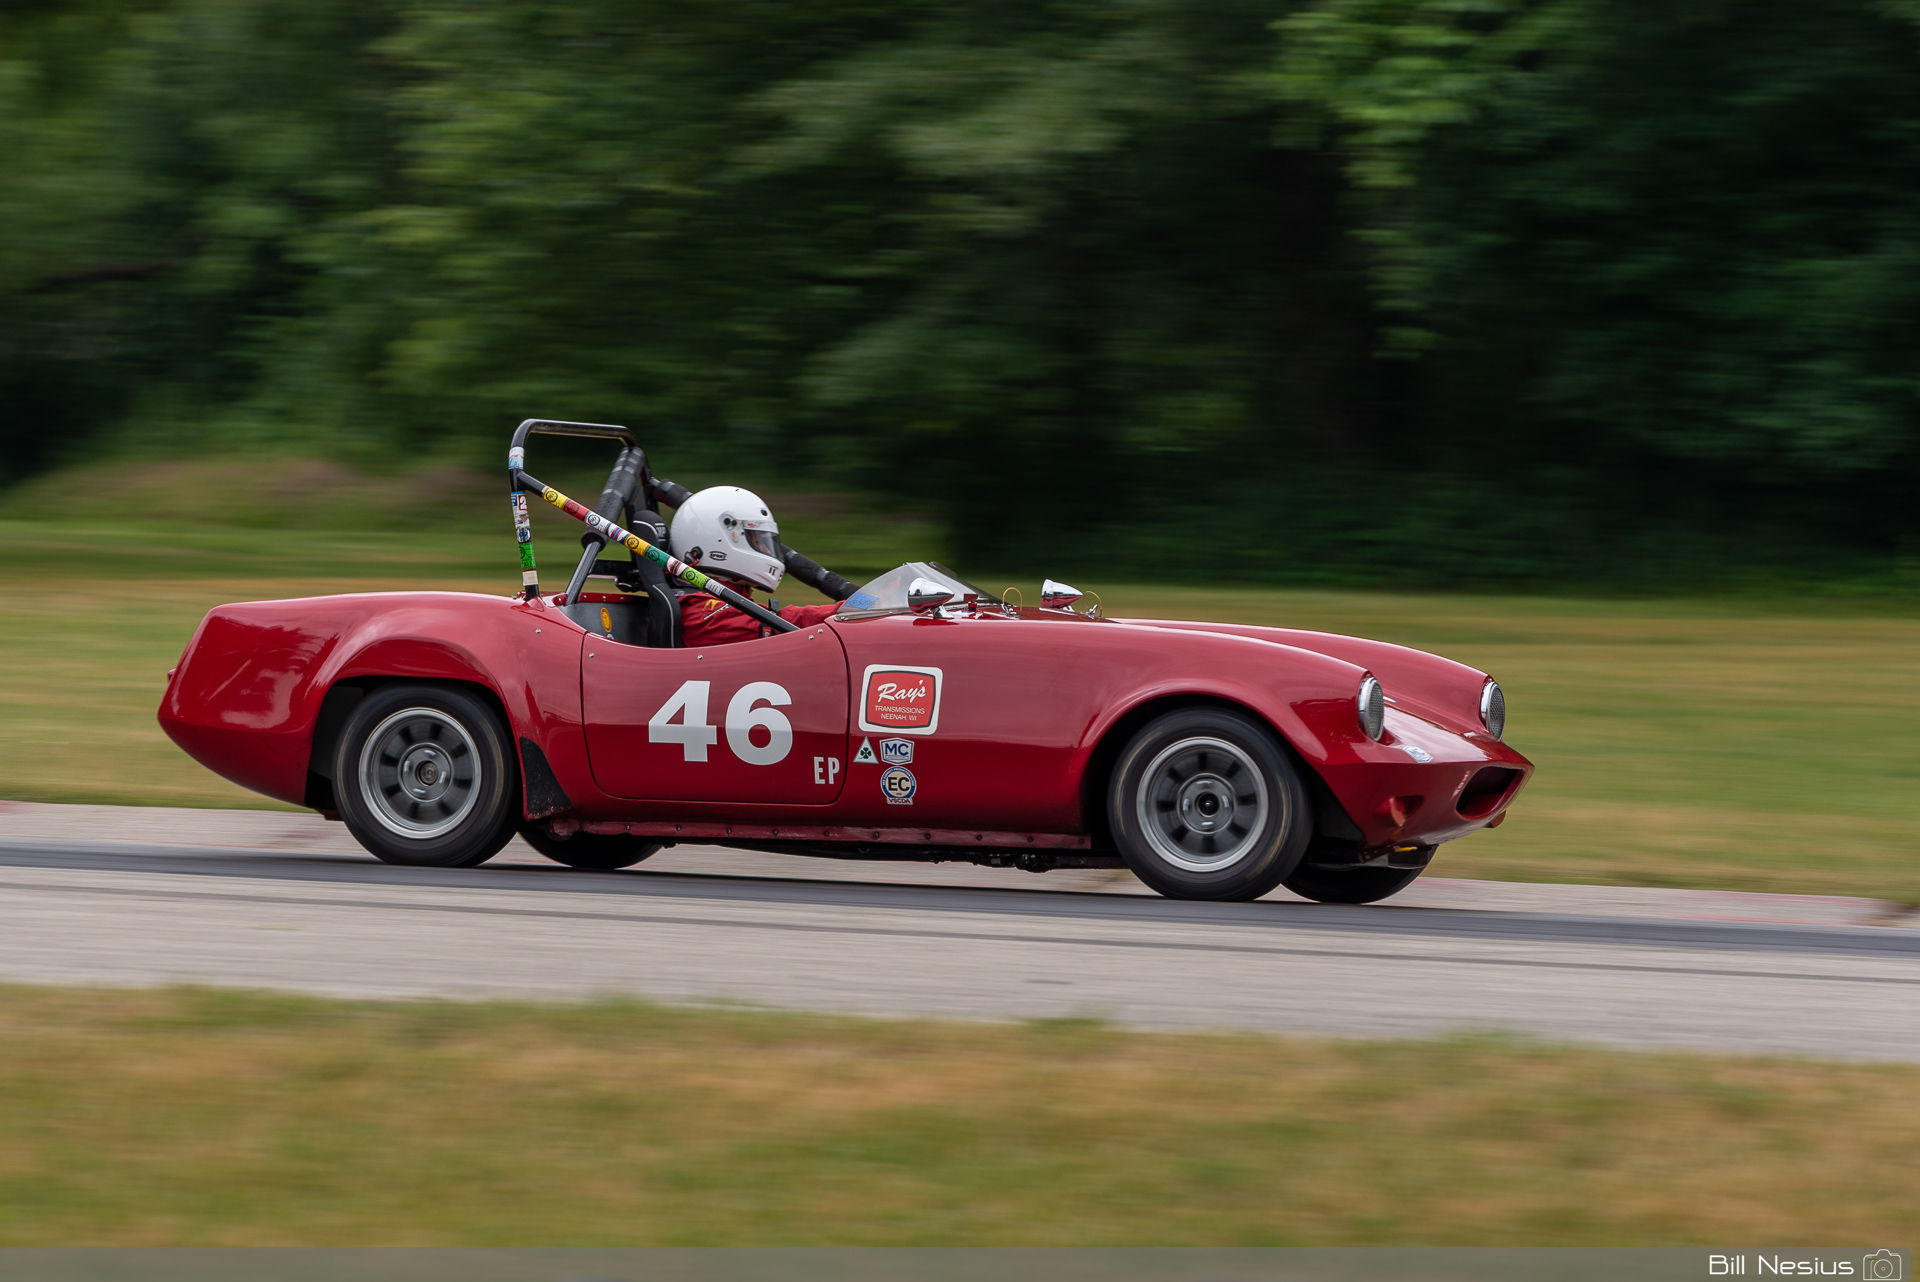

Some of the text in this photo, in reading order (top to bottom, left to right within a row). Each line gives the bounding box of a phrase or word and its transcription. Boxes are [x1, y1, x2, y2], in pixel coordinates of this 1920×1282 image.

[877, 679, 926, 703] Ray's
[874, 705, 925, 715] TRANSMISSIONS
[648, 680, 793, 766] 46
[885, 742, 909, 756] MC
[813, 756, 840, 785] EP
[887, 776, 910, 792] EC
